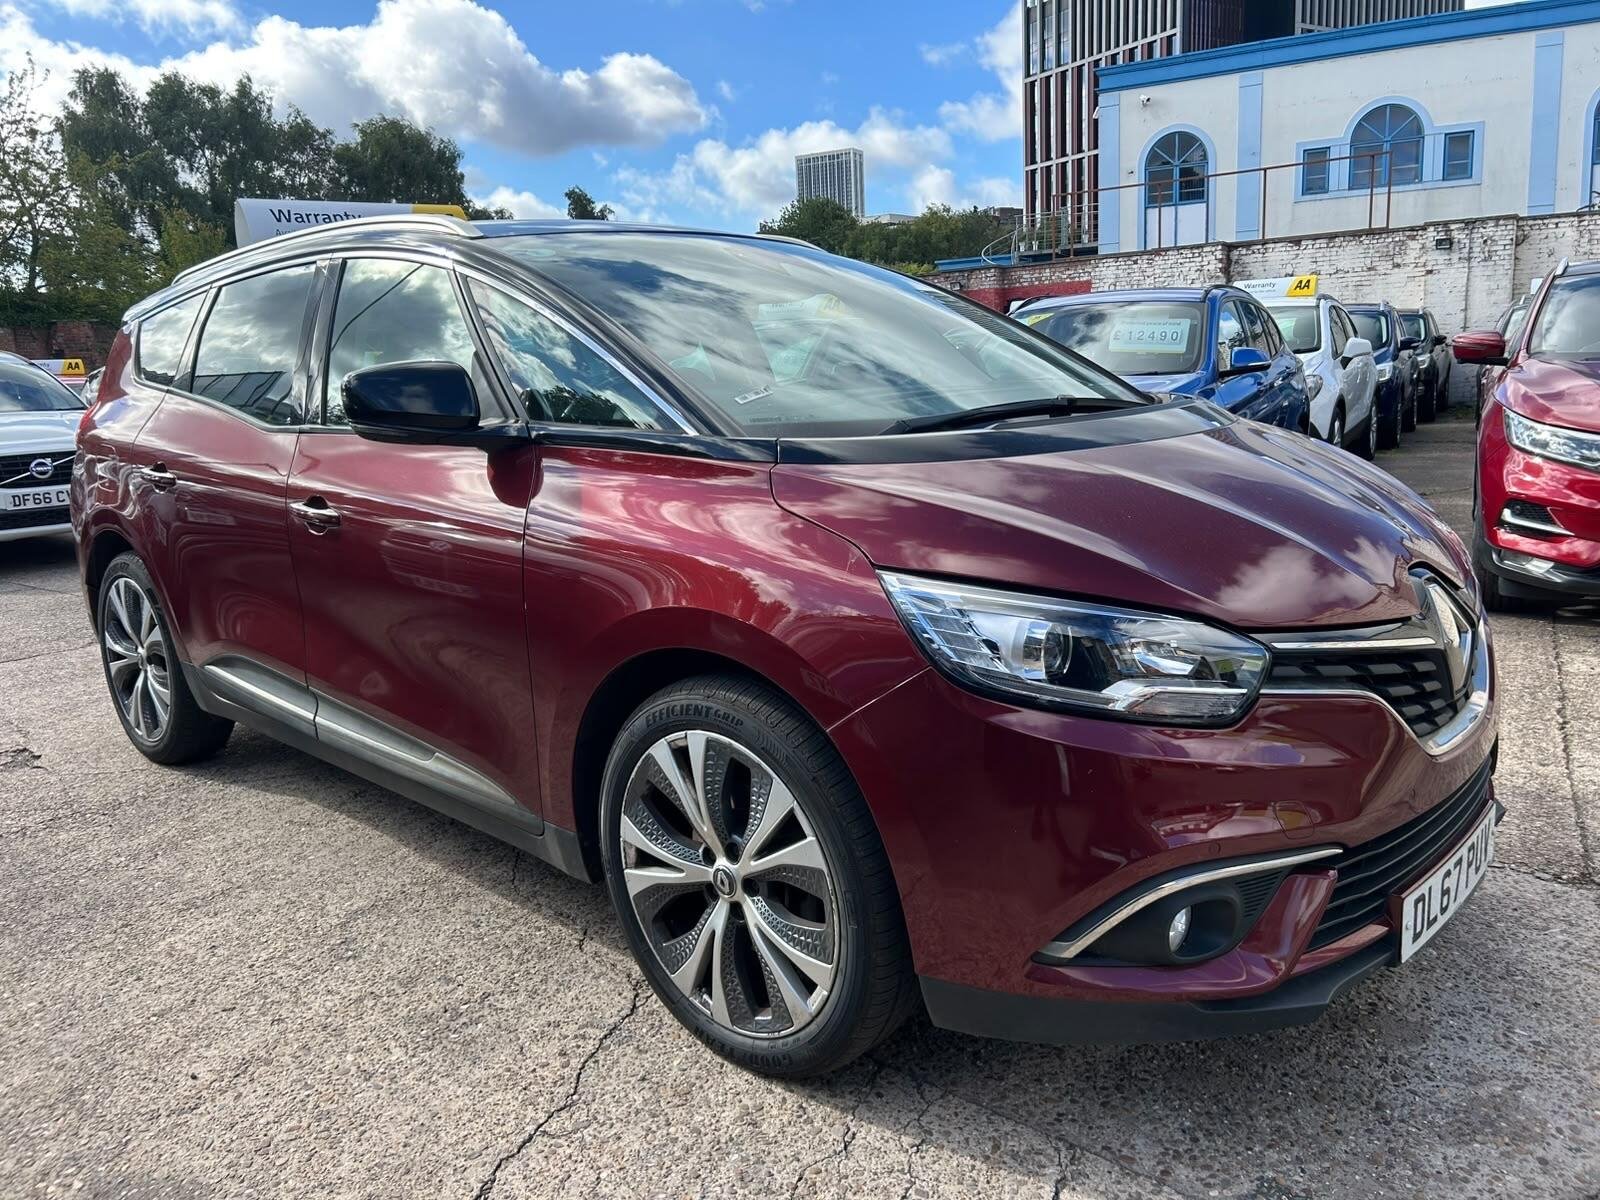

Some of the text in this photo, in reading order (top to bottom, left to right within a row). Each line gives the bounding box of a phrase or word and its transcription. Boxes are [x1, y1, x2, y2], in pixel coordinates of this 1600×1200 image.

[1243, 279, 1311, 290] Warranty AA
[67, 362, 80, 371] AA
[12, 491, 52, 507] DF66
[1412, 817, 1491, 944] DL67 PUV
